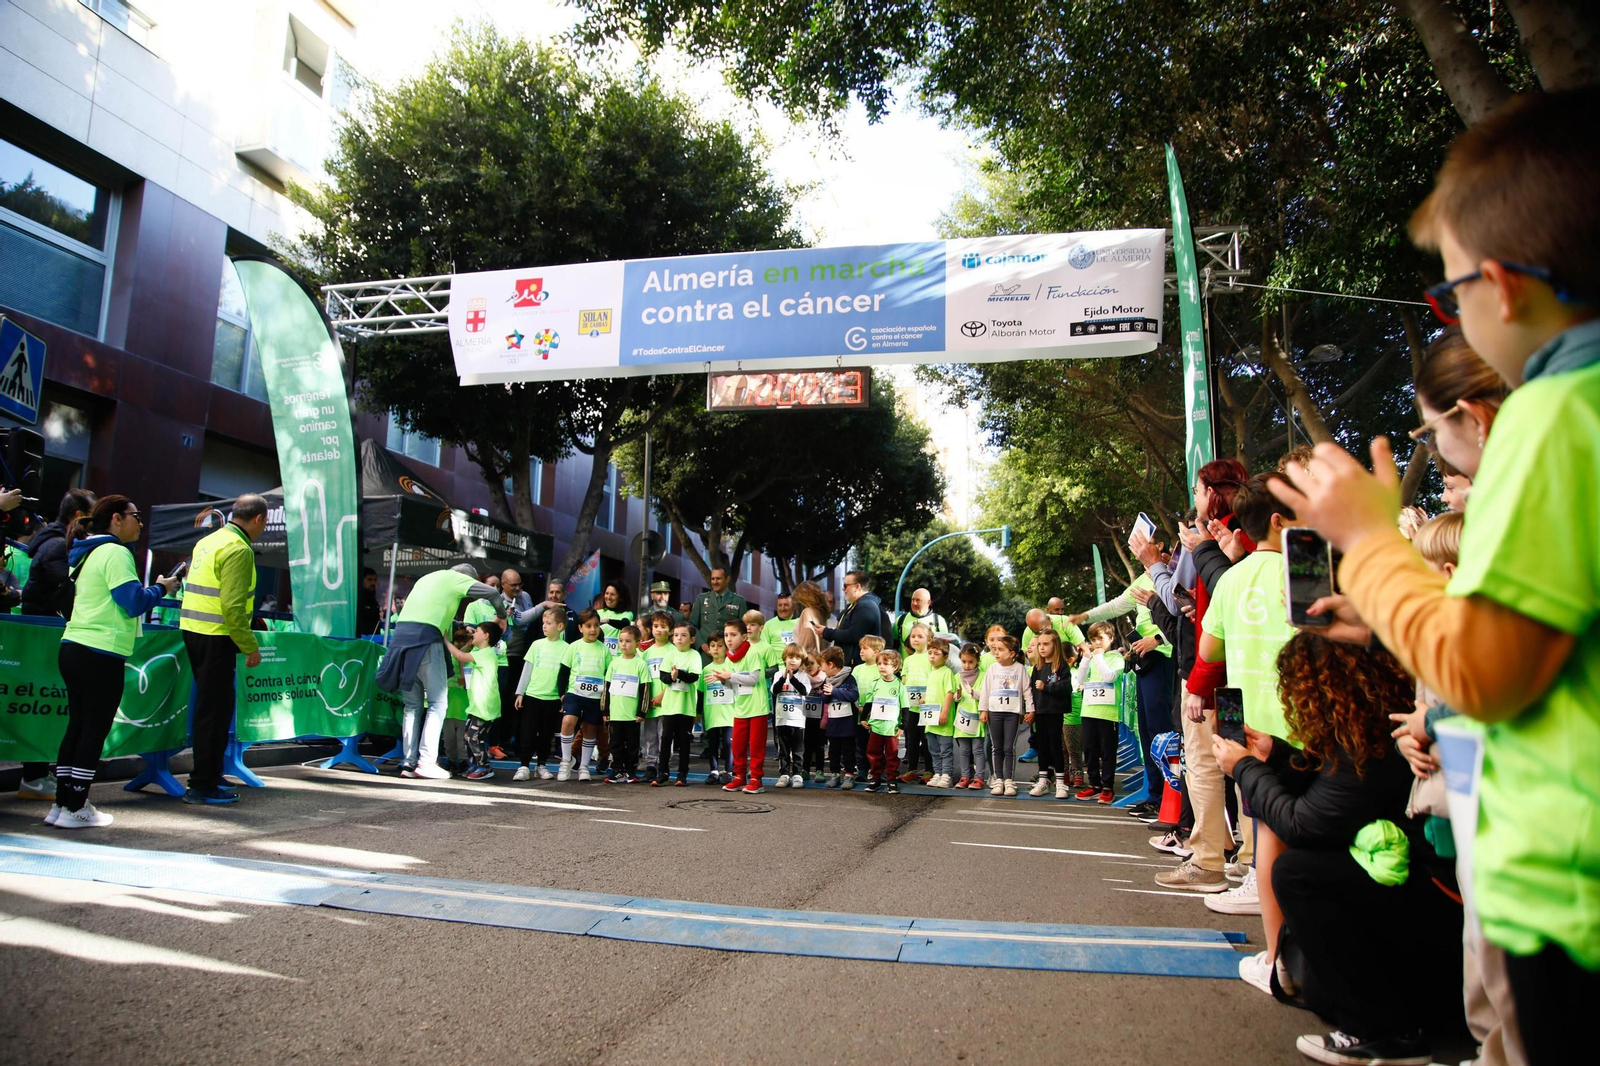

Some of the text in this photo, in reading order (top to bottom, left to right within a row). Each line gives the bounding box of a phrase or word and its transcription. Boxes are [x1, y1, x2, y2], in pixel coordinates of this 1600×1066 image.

[1095, 247, 1152, 256] UNIVERSIDAD
[985, 252, 1048, 266] cajamar
[1110, 254, 1152, 262] ALMERÍA
[642, 255, 926, 293] Almería en marcha
[1046, 286, 1120, 300] Fundación
[641, 292, 886, 325] contra el cáncer
[1084, 305, 1145, 318] Ejido Motor
[582, 312, 608, 323] SOLAN
[991, 319, 1023, 328] Toyota
[1119, 322, 1131, 331] FIAT
[870, 324, 937, 334] asociación española
[991, 327, 1056, 338] Alborán Motor
[894, 332, 901, 340] el
[901, 332, 923, 340] cáncer
[455, 335, 493, 348] ALMERÍA
[882, 340, 909, 348] Almería
[632, 343, 726, 357] #TodosContraElCáncer
[245, 674, 283, 688] Contra
[285, 672, 295, 686] el
[15, 681, 35, 698] el
[580, 682, 599, 692] 886
[246, 692, 283, 704] somos
[285, 687, 304, 700] solo
[712, 689, 725, 698] 95
[910, 692, 922, 700] 23
[1092, 688, 1106, 698] 32
[998, 696, 1010, 705] 11
[6, 699, 52, 716] solo
[782, 703, 795, 712] 98
[832, 702, 843, 711] 17
[880, 704, 885, 713] 1
[923, 711, 933, 719] 15
[959, 716, 971, 727] 31
